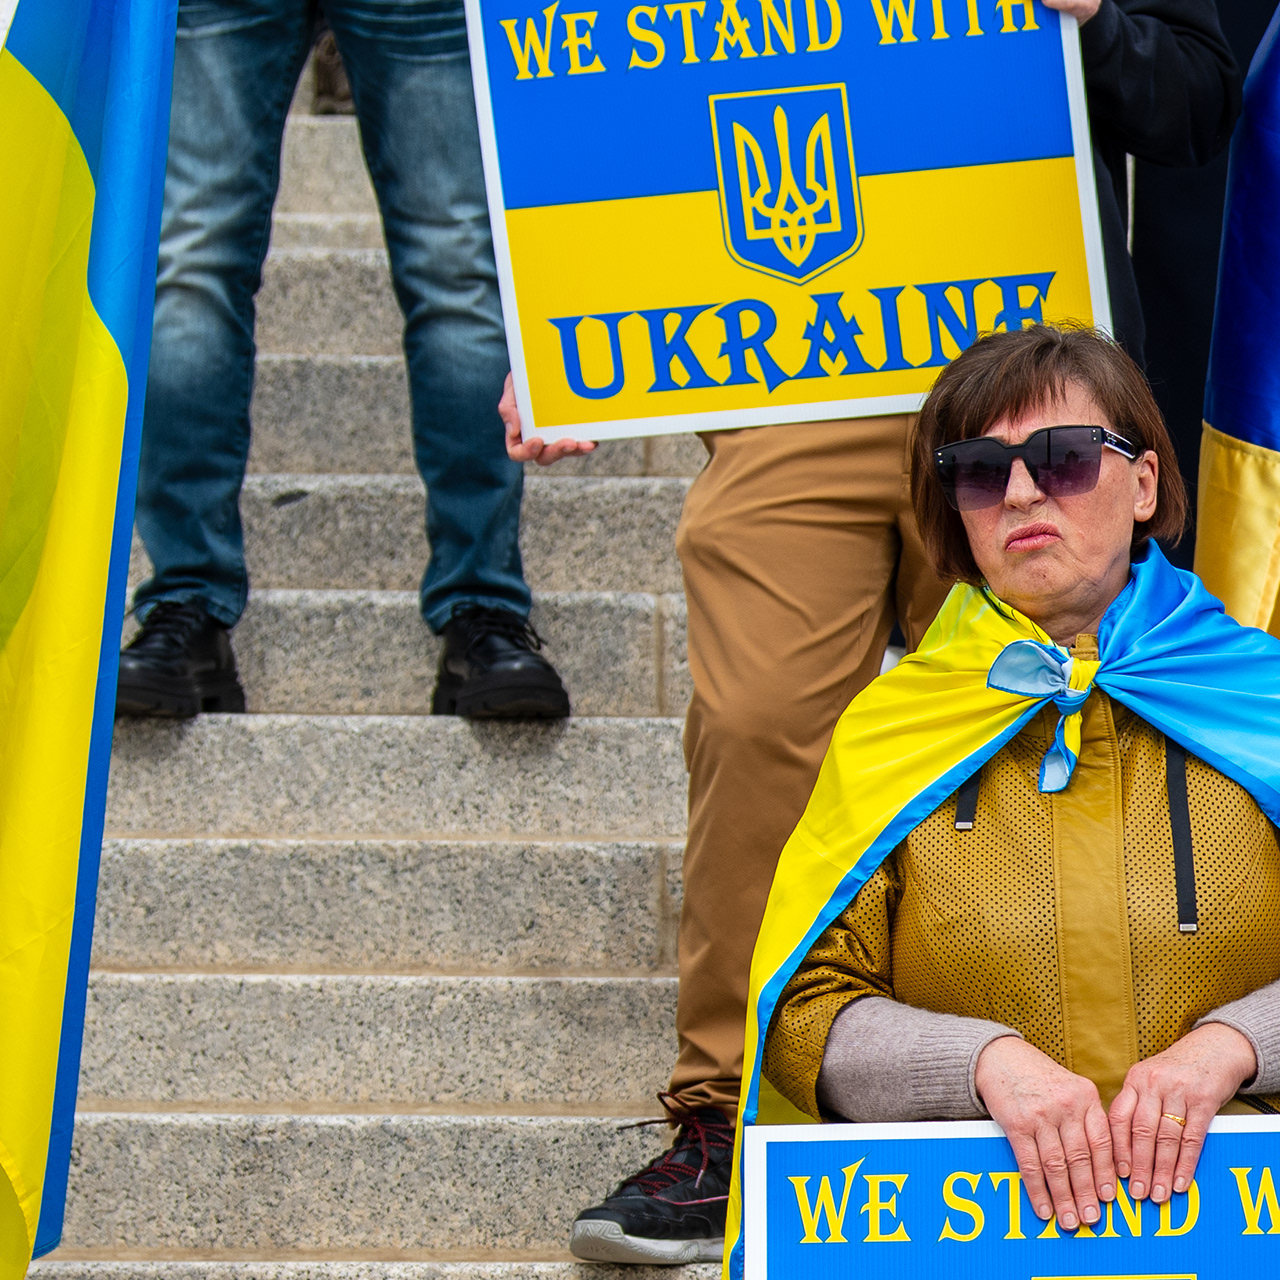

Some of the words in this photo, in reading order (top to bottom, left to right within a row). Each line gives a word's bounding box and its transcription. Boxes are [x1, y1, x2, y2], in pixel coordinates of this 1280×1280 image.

[499, 0, 607, 81] WE
[625, 0, 843, 72] STAND
[548, 271, 1057, 400] UKRAINE
[787, 1152, 912, 1244] WE
[936, 1170, 1201, 1243] STND
